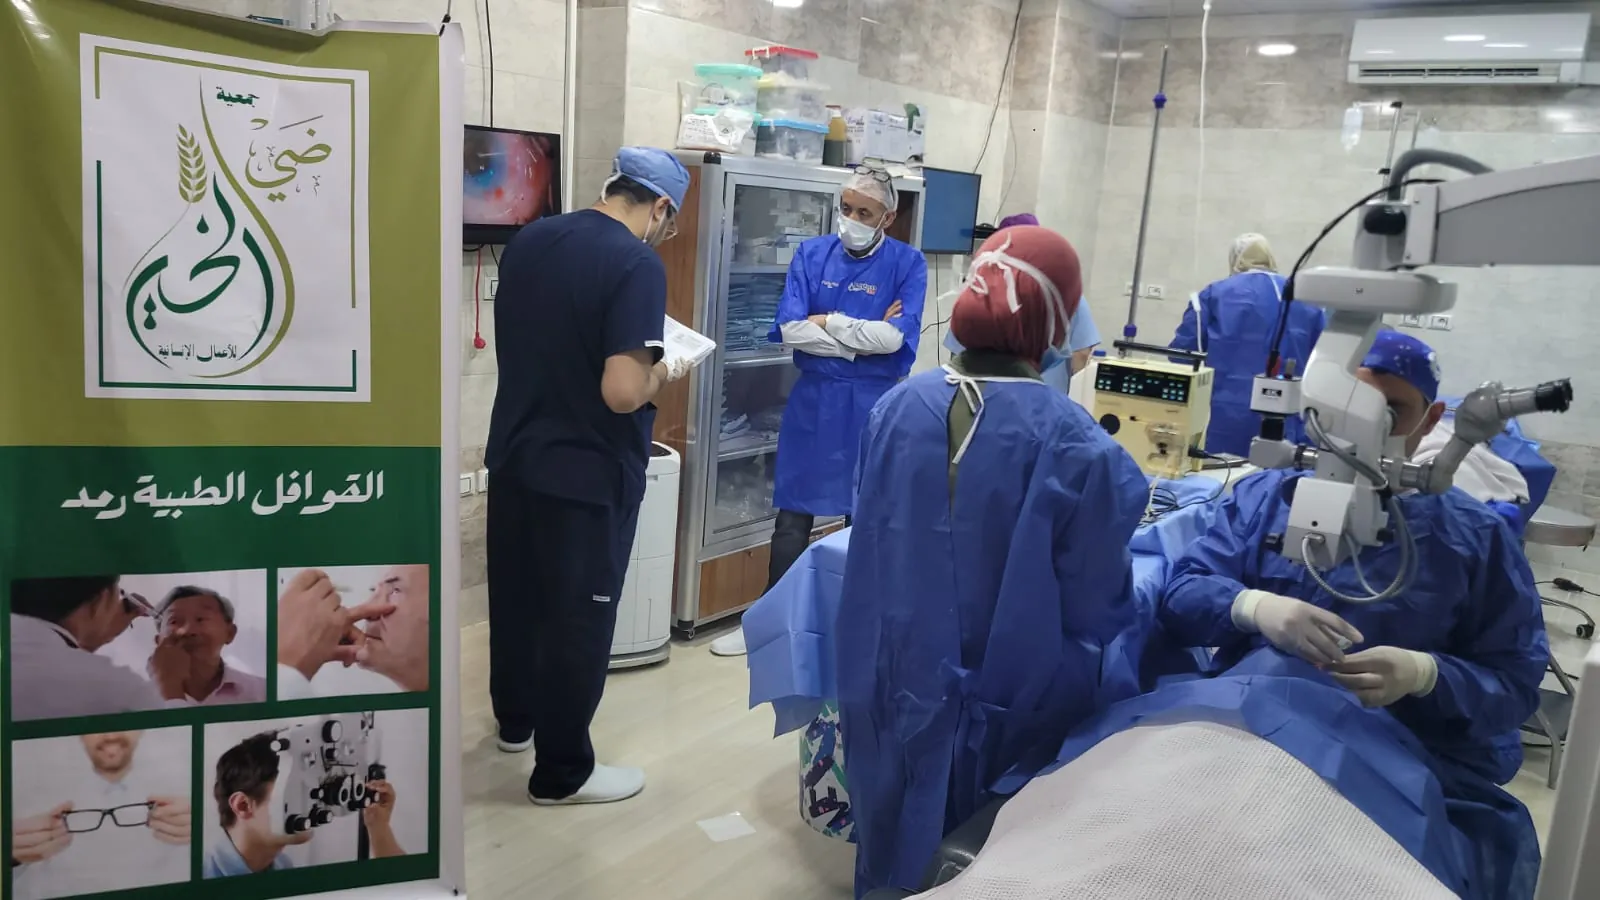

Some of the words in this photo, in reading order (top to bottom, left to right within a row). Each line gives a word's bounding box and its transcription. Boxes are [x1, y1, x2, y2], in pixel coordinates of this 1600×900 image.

[215, 86, 260, 108] جمعية
[126, 172, 274, 370] الخير
[158, 342, 195, 360] الإنسانية
[196, 343, 237, 362] للأعمال
[60, 485, 127, 520] رمد
[133, 469, 246, 519] الطبية
[251, 469, 384, 516] القوافل
